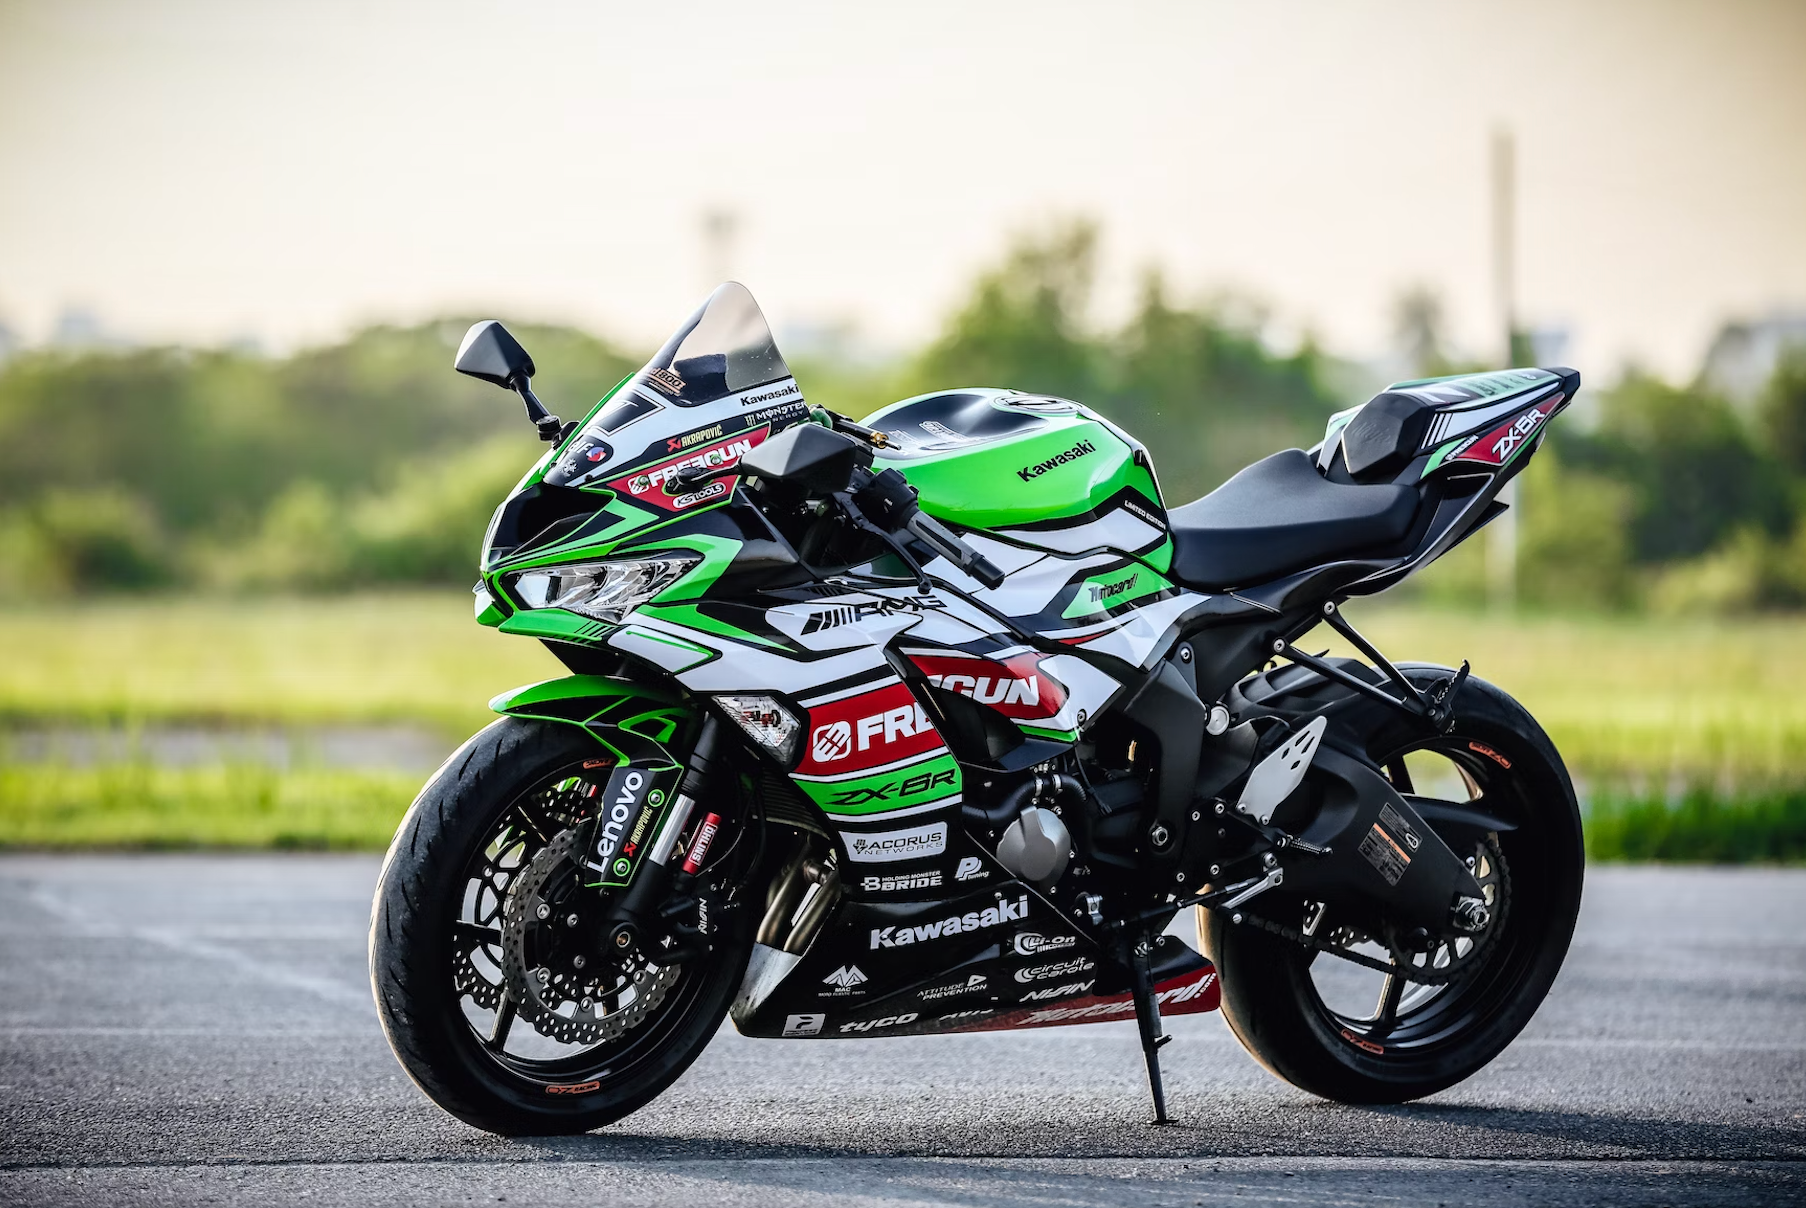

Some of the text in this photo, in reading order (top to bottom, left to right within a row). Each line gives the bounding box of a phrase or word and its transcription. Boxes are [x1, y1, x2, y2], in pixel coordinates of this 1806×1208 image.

[740, 383, 799, 407] Kawasaki
[1016, 439, 1096, 482] Kawasaki
[1124, 499, 1166, 531] LIMITED EDITION
[824, 768, 957, 806] ZX-6R
[586, 771, 643, 873] Lenovo
[865, 842, 943, 855] NETWORKS
[867, 832, 942, 850] ACORUS
[880, 876, 942, 891] BRIDE
[881, 870, 941, 882] HOLDING MONSTER
[870, 895, 1028, 950] Kawasaki
[916, 982, 965, 998] ATTITUDE
[922, 984, 987, 1000] PREVENTION
